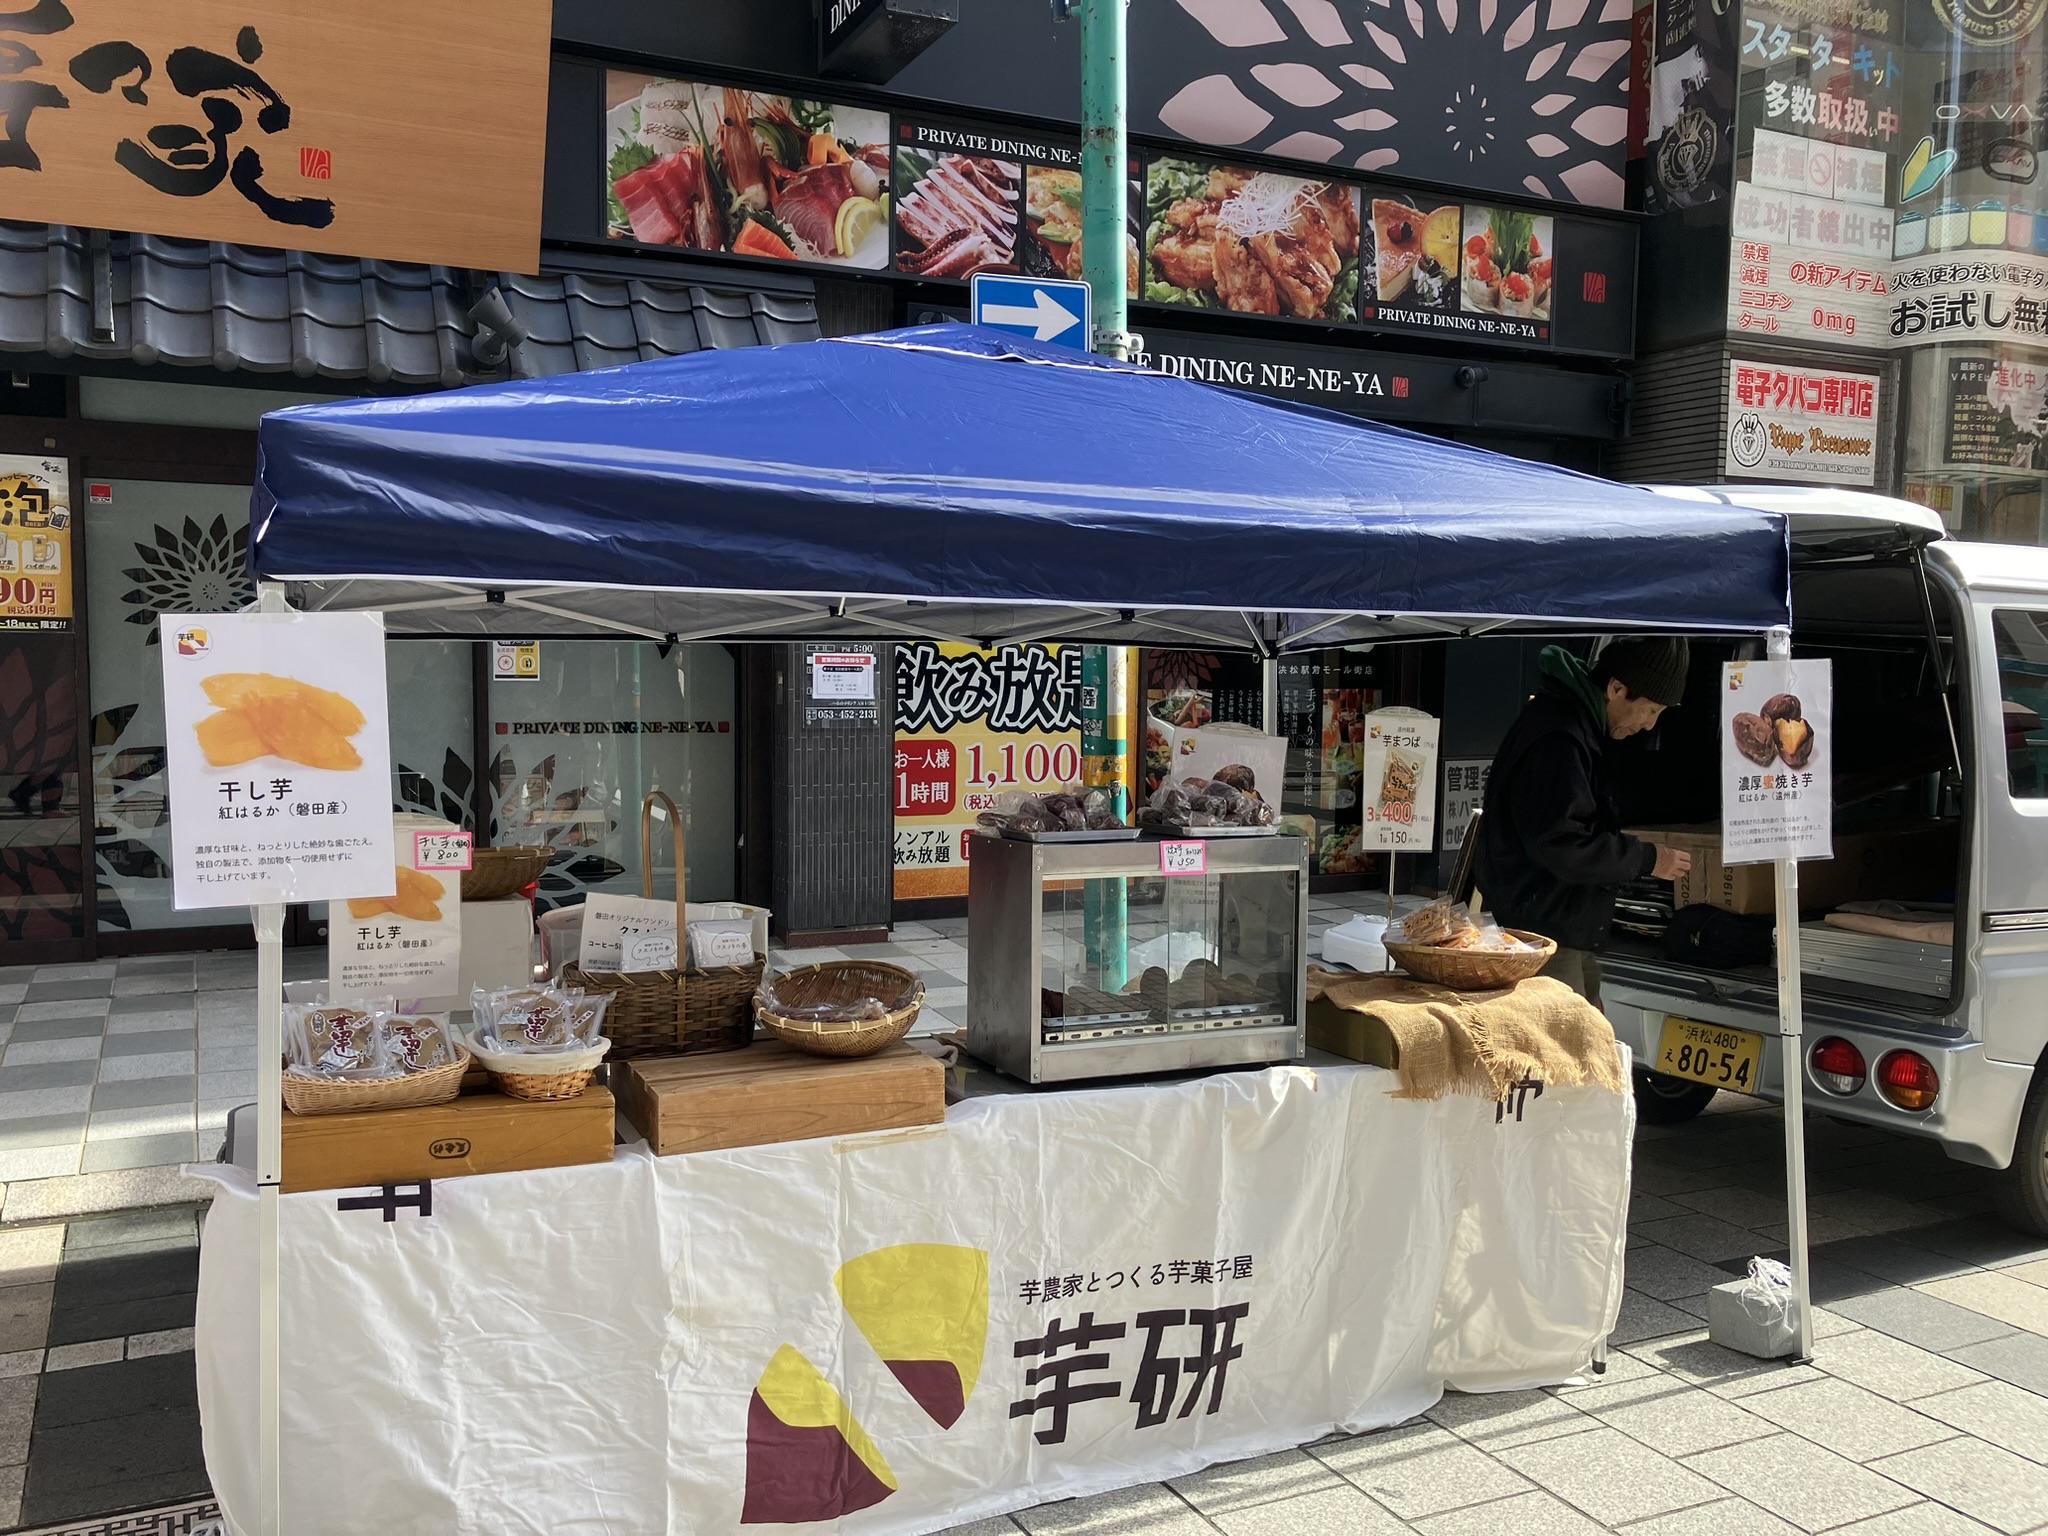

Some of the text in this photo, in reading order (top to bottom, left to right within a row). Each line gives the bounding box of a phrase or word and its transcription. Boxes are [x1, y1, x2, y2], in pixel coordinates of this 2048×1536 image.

[1742, 19, 1902, 88] スターターキット
[1764, 80, 1900, 142] 多数取扱い中
[917, 126, 1083, 165] PRIVATE DINING NE-
[1735, 196, 1891, 250] 成功者続出中
[1742, 242, 1770, 262] 禁煙
[1741, 265, 1769, 287] 減煙
[1789, 261, 1889, 295] の新アイテム
[1890, 264, 2048, 293] 火を使わない電子タ
[1739, 290, 1793, 311] ニコチン
[1377, 306, 1537, 338] PRIVATE DINING NE-NE-YA
[1738, 312, 1779, 333] タール
[1159, 353, 1255, 386] DINING
[1260, 363, 1385, 397] NE-NE-YA
[1994, 366, 2037, 390] 進化中
[1735, 365, 1876, 419] 電子タバコ専門店
[0, 480, 50, 528] 泡
[853, 644, 873, 653] 5:00
[1278, 665, 1373, 676] 浜松駅前モール街店
[818, 709, 878, 719] 053-452-2131
[512, 721, 716, 735] PRIVATE DINING NE-NE-YA
[1303, 688, 1317, 808] 手づくりの味を皆様に
[1382, 735, 1421, 748] 芋まつば
[894, 748, 951, 769] お一人様
[967, 742, 1083, 789] 1,100
[218, 778, 294, 803] 干し芋
[896, 771, 950, 809] 1時間
[1738, 772, 1814, 791] 濃厚蜜焼き芋
[1738, 789, 1804, 803] 紅はるか（遠州産）
[218, 800, 349, 820] 紅はるか（磐田産）
[194, 837, 374, 855] 濃厚な甘味と、ねっとりした絶妙な歯ごたえ。
[894, 830, 951, 846] ノンアル
[196, 852, 353, 870] 独自の製法で、添加物を一切使用せずに
[197, 870, 272, 884] 干し上げています。
[357, 925, 402, 941] 干し芋
[357, 938, 435, 951] 紅はるか（磐田産）
[1677, 1044, 1751, 1088] 80-54
[1019, 1255, 1254, 1306] 芋農家とつくる芋菓子屋
[1009, 1301, 1250, 1446] 芋研
